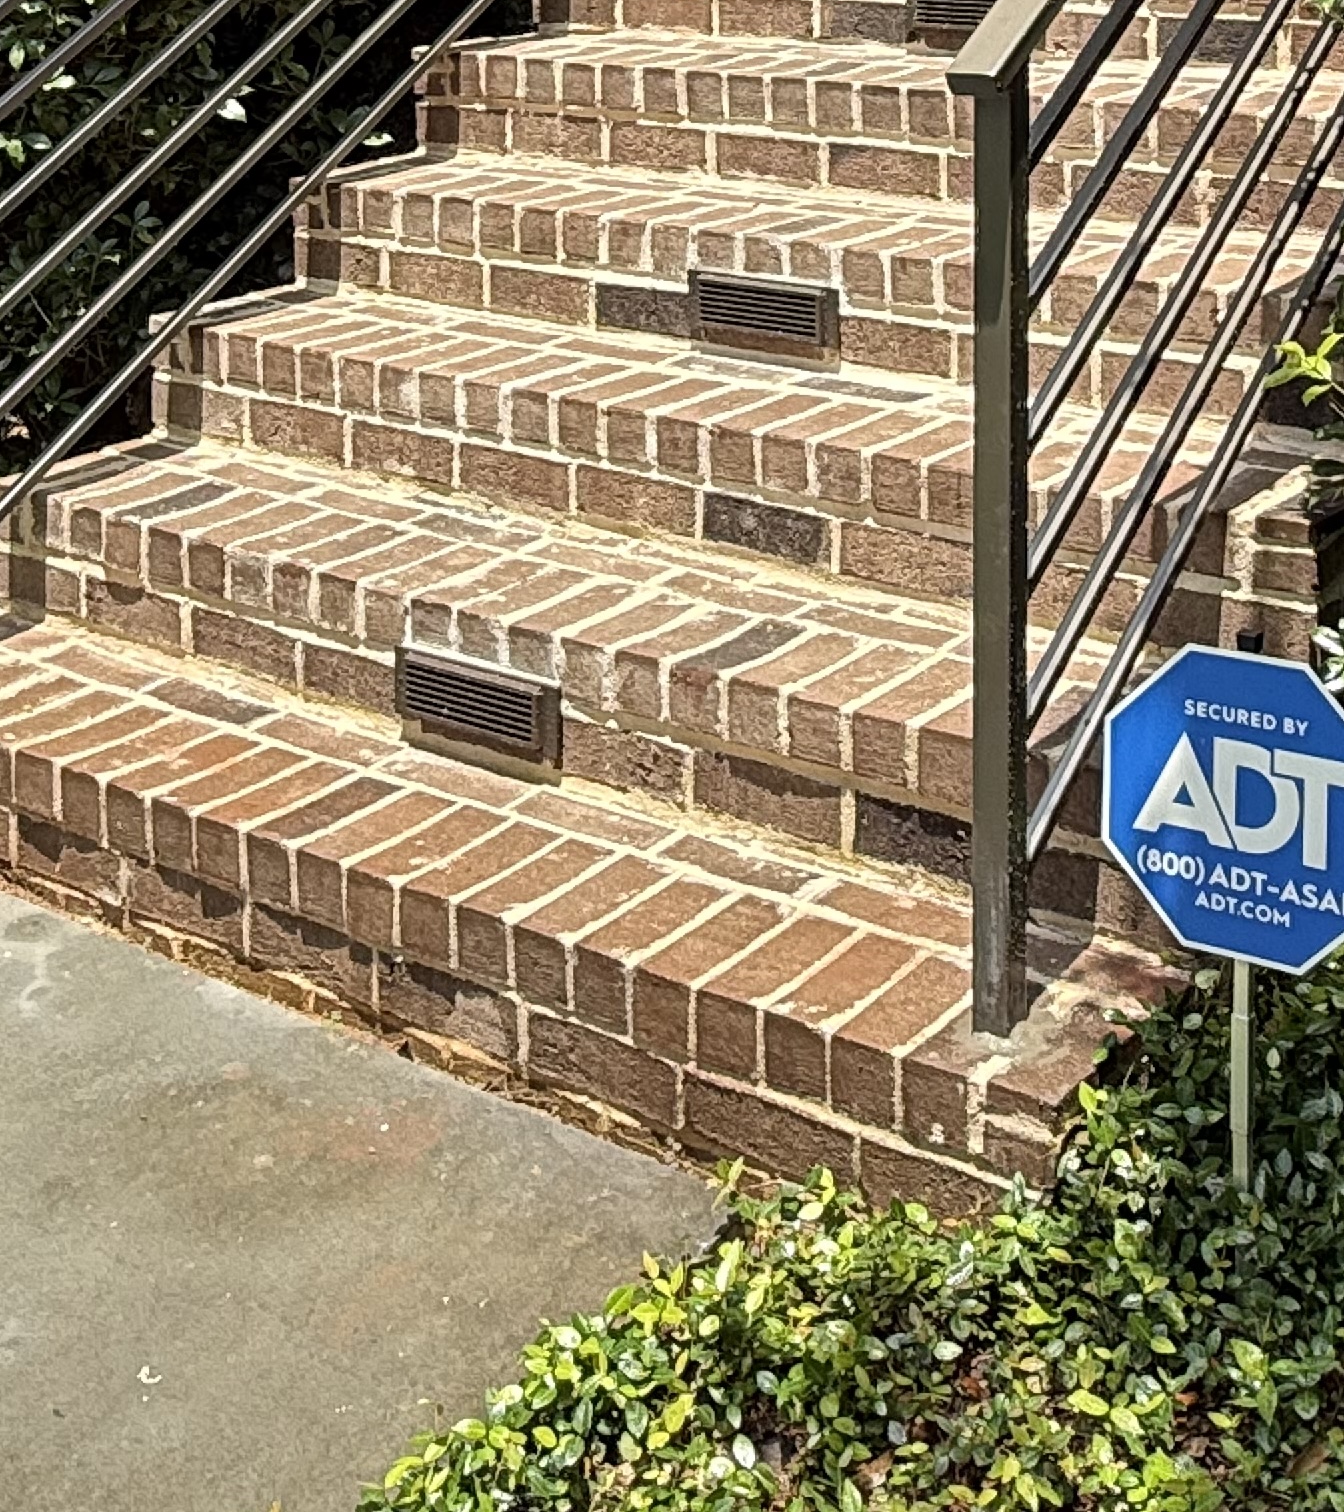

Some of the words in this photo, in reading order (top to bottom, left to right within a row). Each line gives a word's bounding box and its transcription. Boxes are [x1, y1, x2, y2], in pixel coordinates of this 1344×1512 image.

[1183, 698, 1278, 731] SECURED
[1282, 719, 1309, 737] BY
[1136, 844, 1206, 885] (800)
[1194, 890, 1290, 928] ADT.COM
